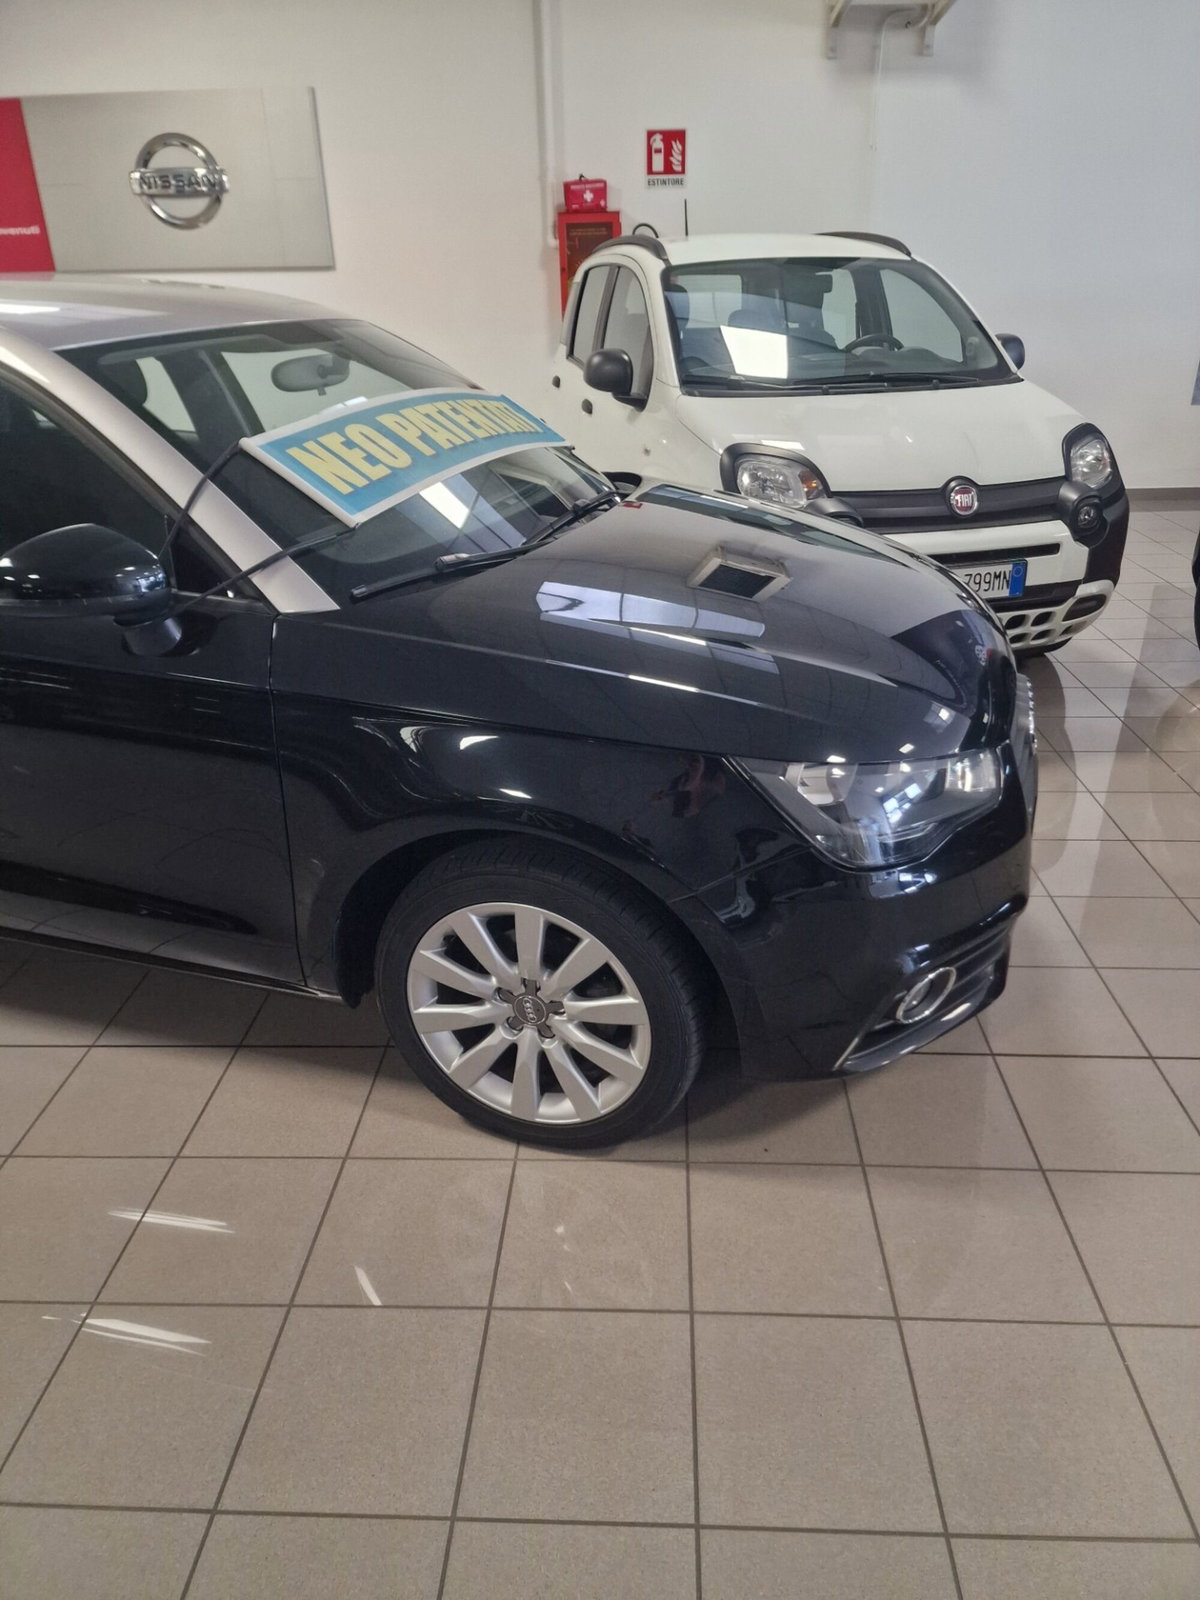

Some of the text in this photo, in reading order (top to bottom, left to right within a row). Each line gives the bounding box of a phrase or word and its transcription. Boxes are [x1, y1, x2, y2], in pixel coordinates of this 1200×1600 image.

[139, 174, 217, 189] NISSAN
[648, 178, 684, 186] ESTINTORE
[286, 423, 412, 495] NEO
[956, 493, 973, 506] FIAT
